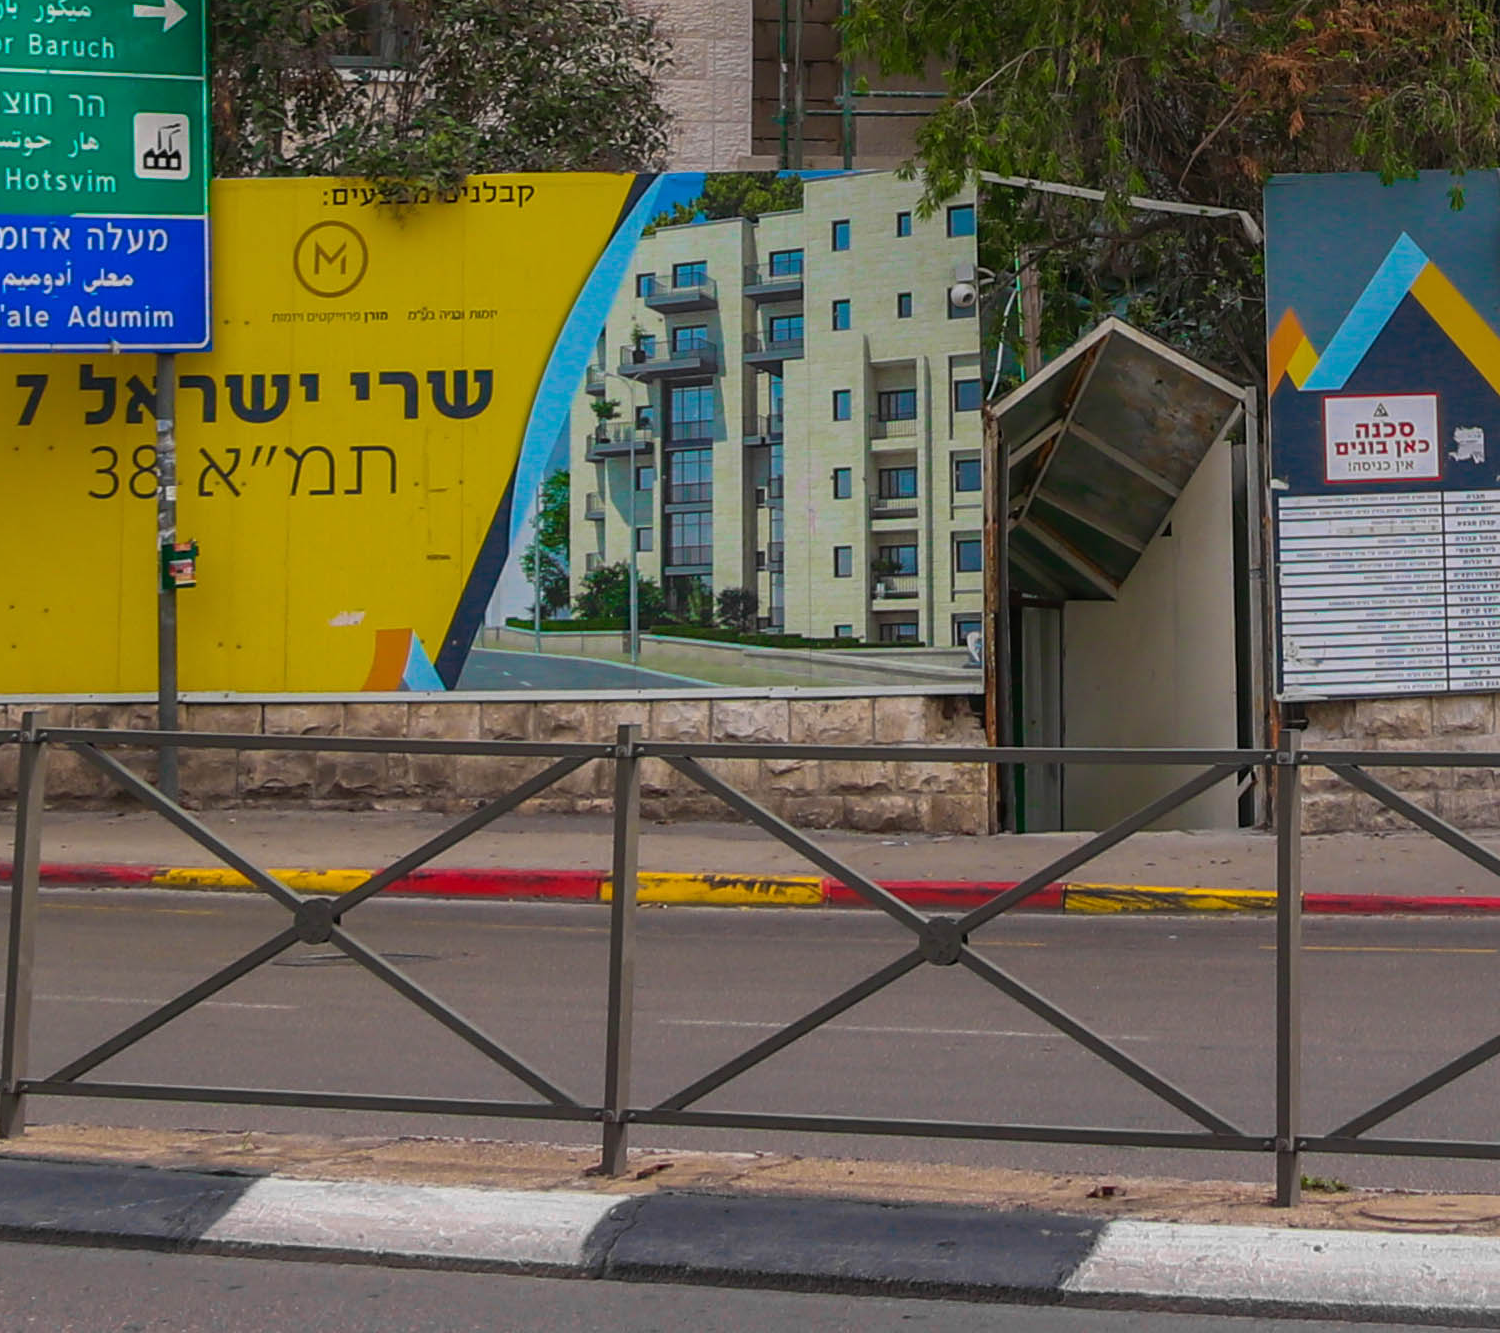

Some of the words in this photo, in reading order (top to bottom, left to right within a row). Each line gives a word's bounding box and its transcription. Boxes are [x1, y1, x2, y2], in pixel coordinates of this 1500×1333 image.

[28, 33, 116, 59] Baruch
[68, 92, 105, 118] הר
[67, 131, 100, 158] هار
[5, 168, 118, 194] Hotsvim
[322, 185, 430, 208] מצעים:
[86, 222, 169, 253] מעלה
[67, 305, 175, 330] Adumim
[363, 309, 389, 324] מורן
[14, 372, 50, 427] 7
[79, 363, 320, 425] ישראל
[351, 368, 495, 421] שרי
[1355, 421, 1415, 439] סכנה
[1334, 440, 1389, 456] בונים
[1395, 439, 1431, 458] כאן
[88, 444, 160, 499] 38
[197, 444, 400, 499] תמ"א
[1347, 460, 1392, 473] כניסה!
[1395, 459, 1415, 473] אין
